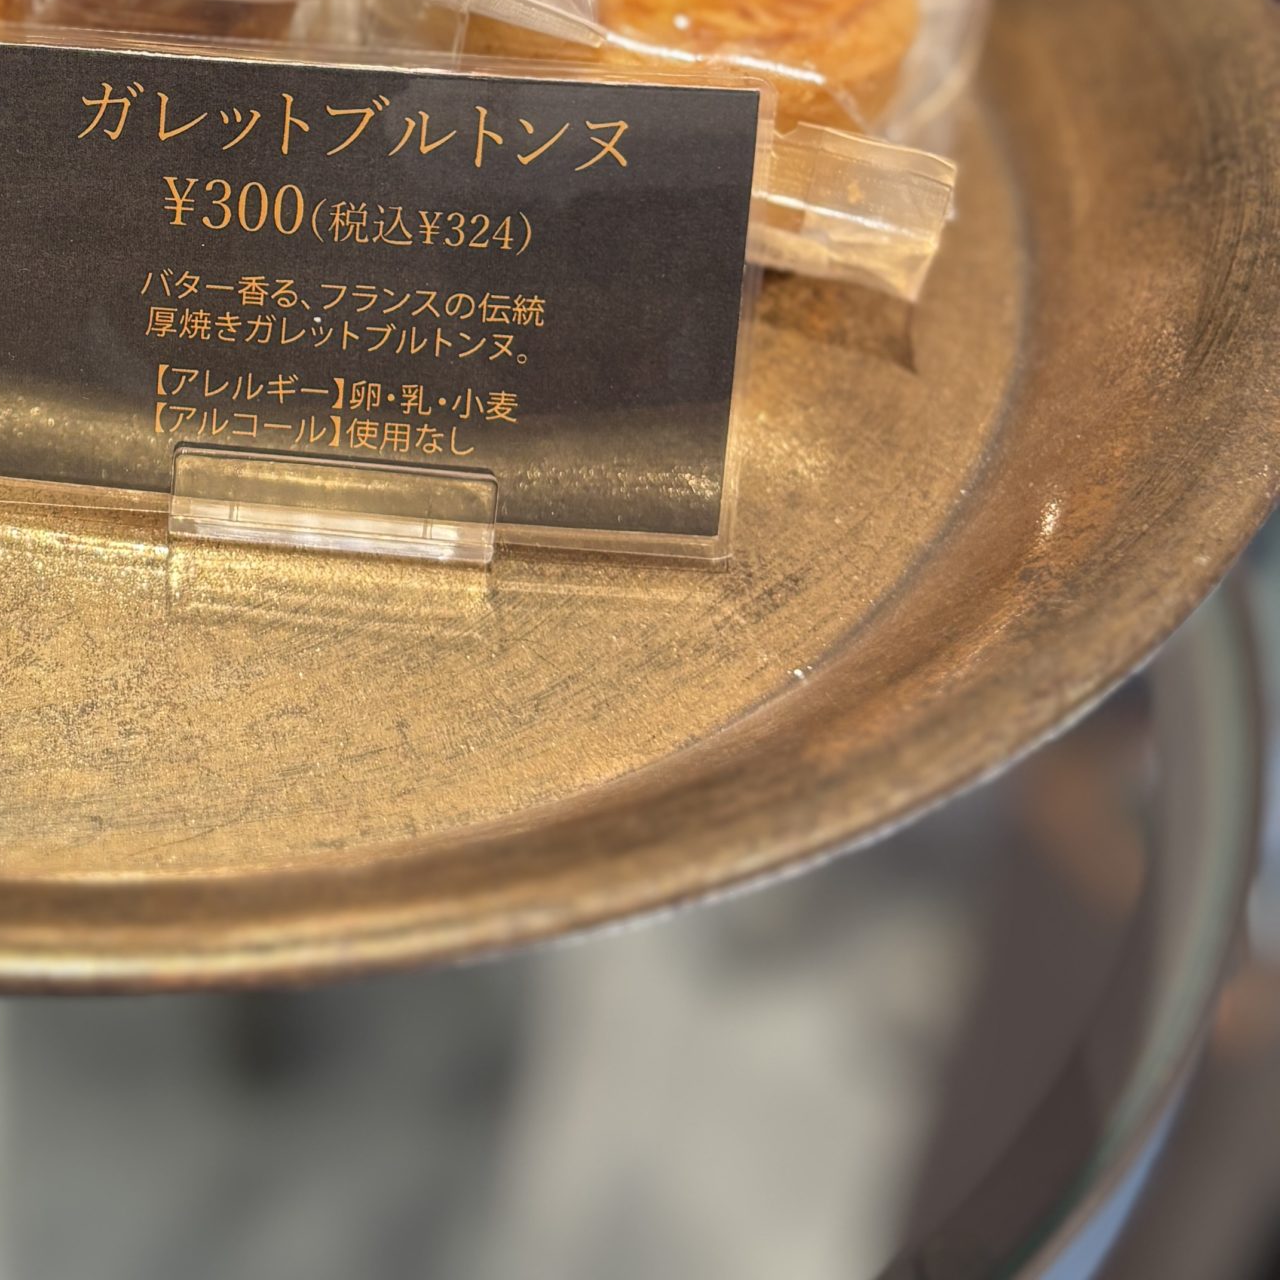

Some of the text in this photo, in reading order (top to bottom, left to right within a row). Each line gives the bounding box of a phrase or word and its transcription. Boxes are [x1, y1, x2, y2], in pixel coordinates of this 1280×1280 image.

[77, 81, 631, 172] ガレットブルトンヌ
[140, 268, 547, 328] バター香る、フランスの伝統
[145, 306, 528, 366] 厚焼きガレットブルトンヌ。
[155, 402, 476, 457] 【アルコール】使用なし
